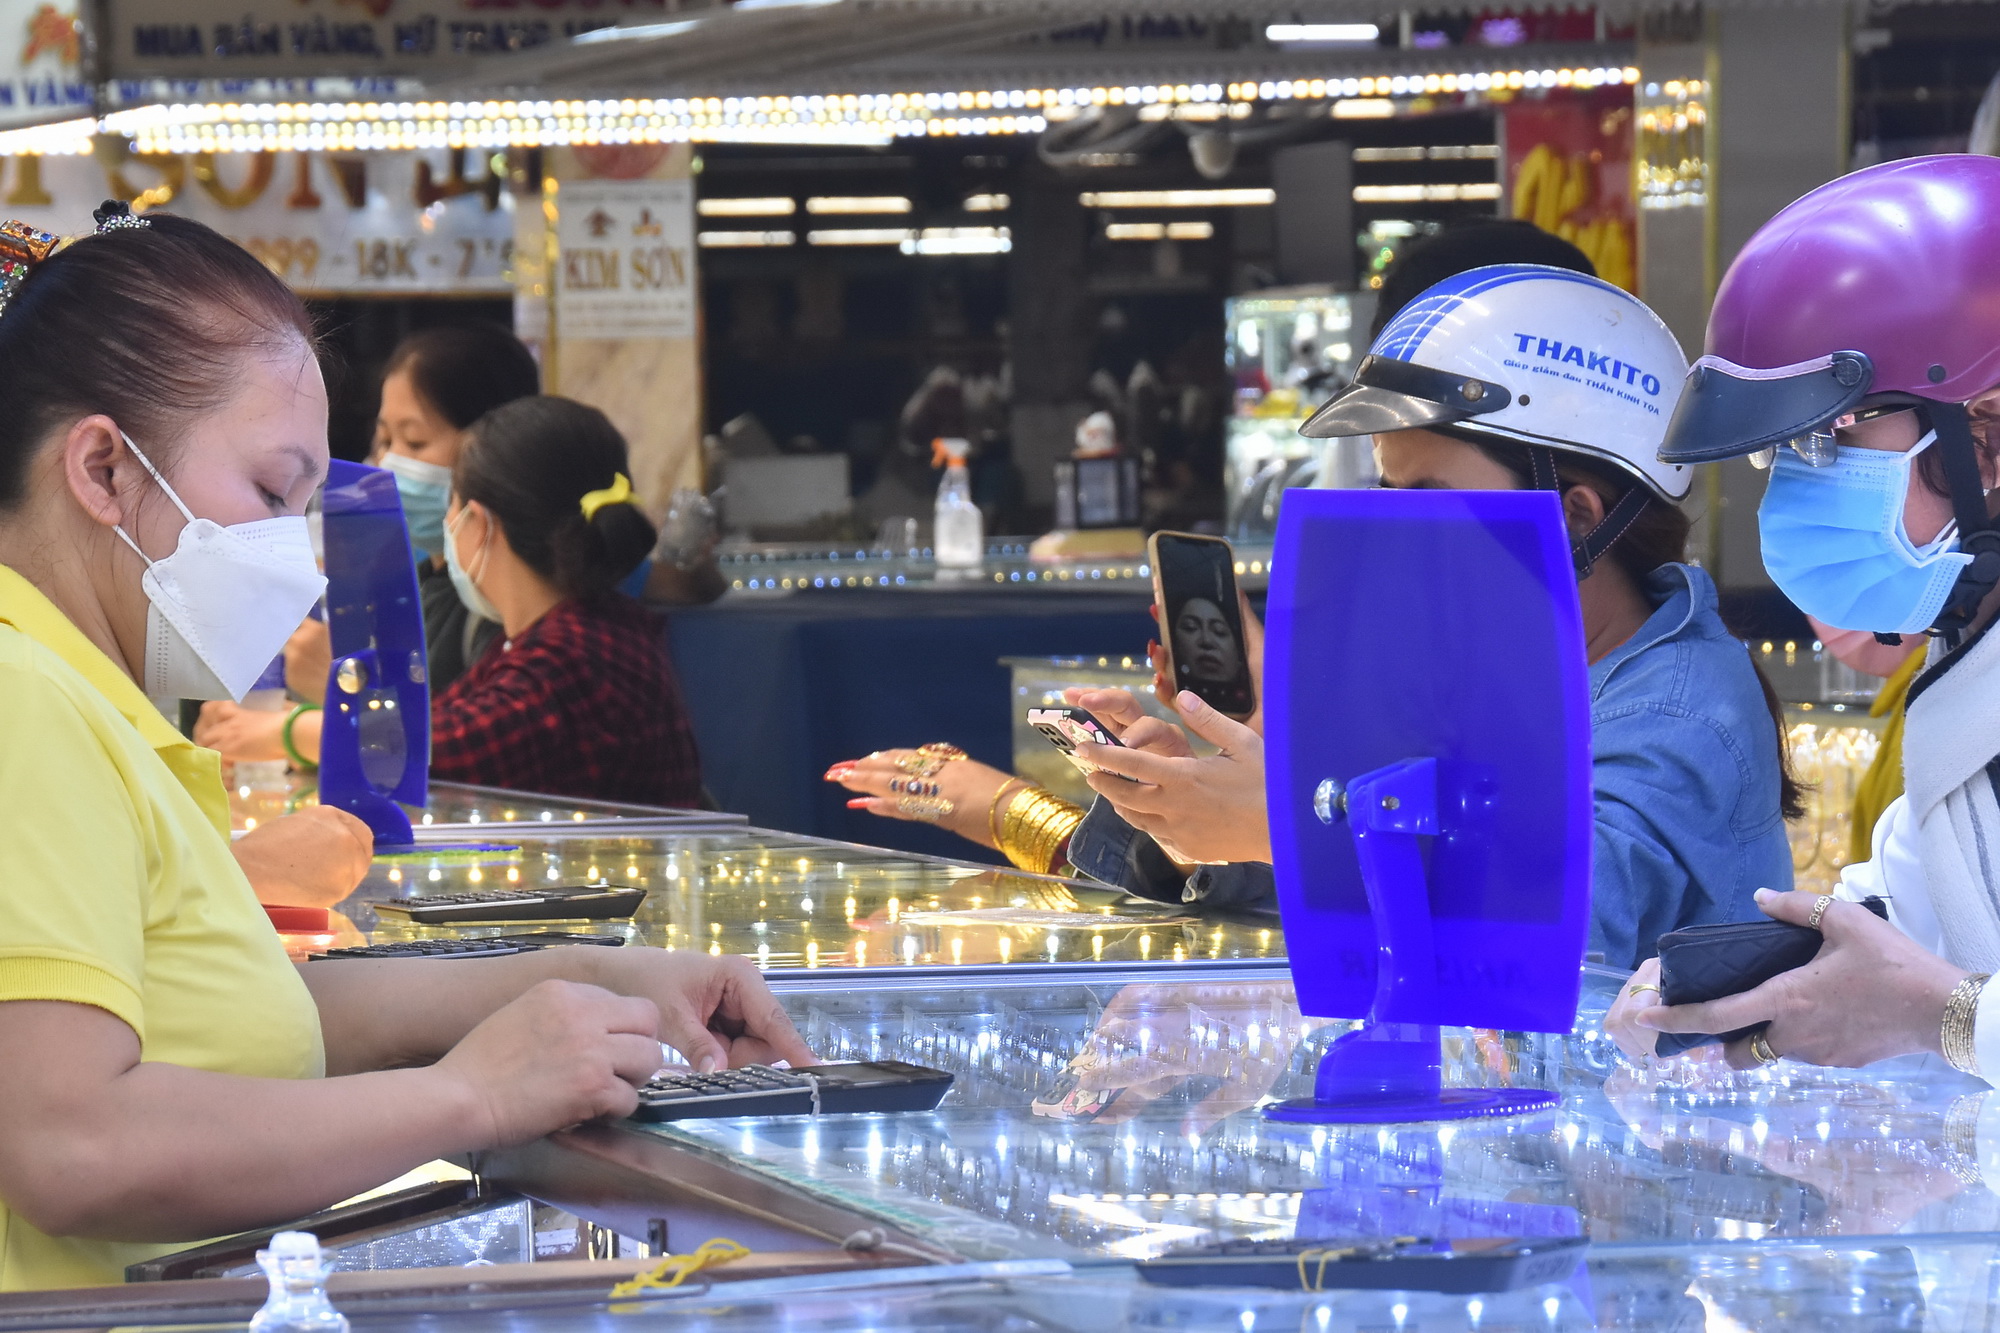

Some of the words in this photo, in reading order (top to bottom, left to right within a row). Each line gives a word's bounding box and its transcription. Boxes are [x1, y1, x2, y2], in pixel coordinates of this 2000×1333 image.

[135, 25, 202, 55] MUA
[564, 248, 620, 290] KIM
[1503, 358, 1529, 370] Giúp
[1617, 389, 1640, 405] KINH
[1514, 333, 1661, 396] THAKITO
